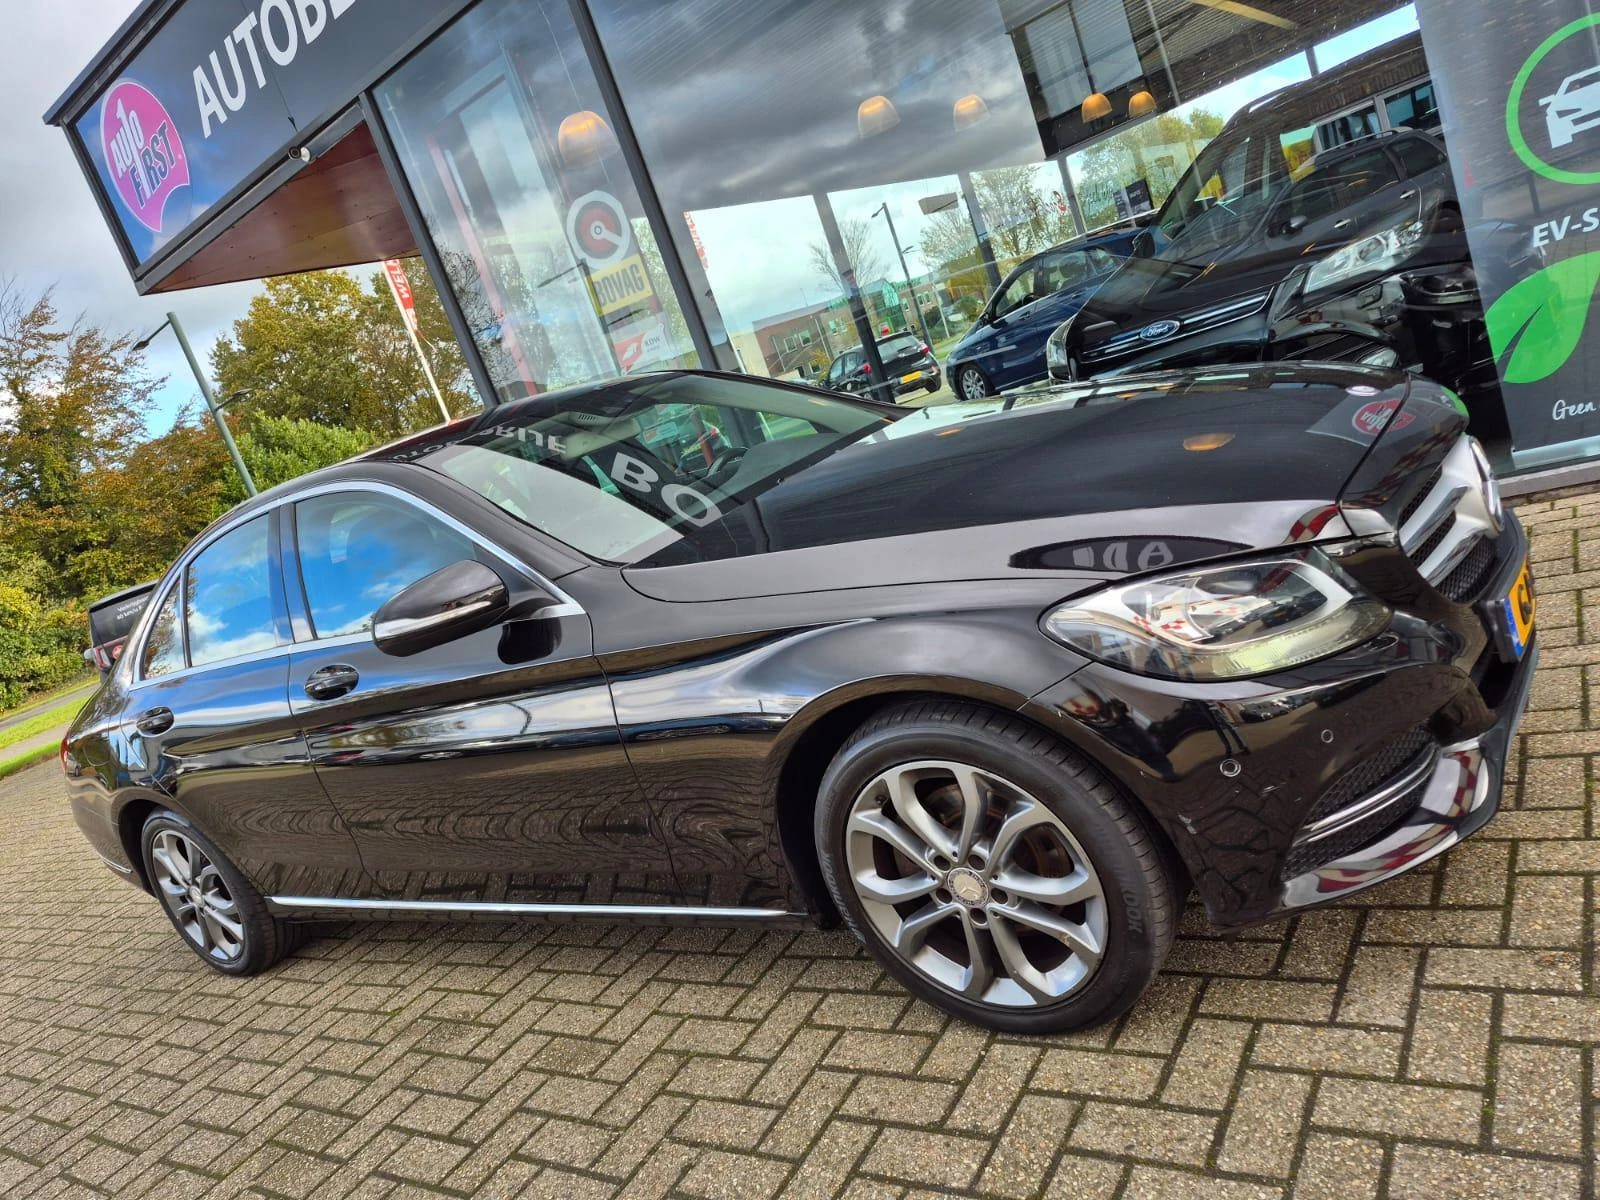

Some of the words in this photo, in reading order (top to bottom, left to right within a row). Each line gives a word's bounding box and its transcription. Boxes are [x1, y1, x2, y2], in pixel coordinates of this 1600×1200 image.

[193, 0, 356, 139] AUTOB
[129, 119, 176, 209] FIRST
[1552, 399, 1597, 420] Geen
